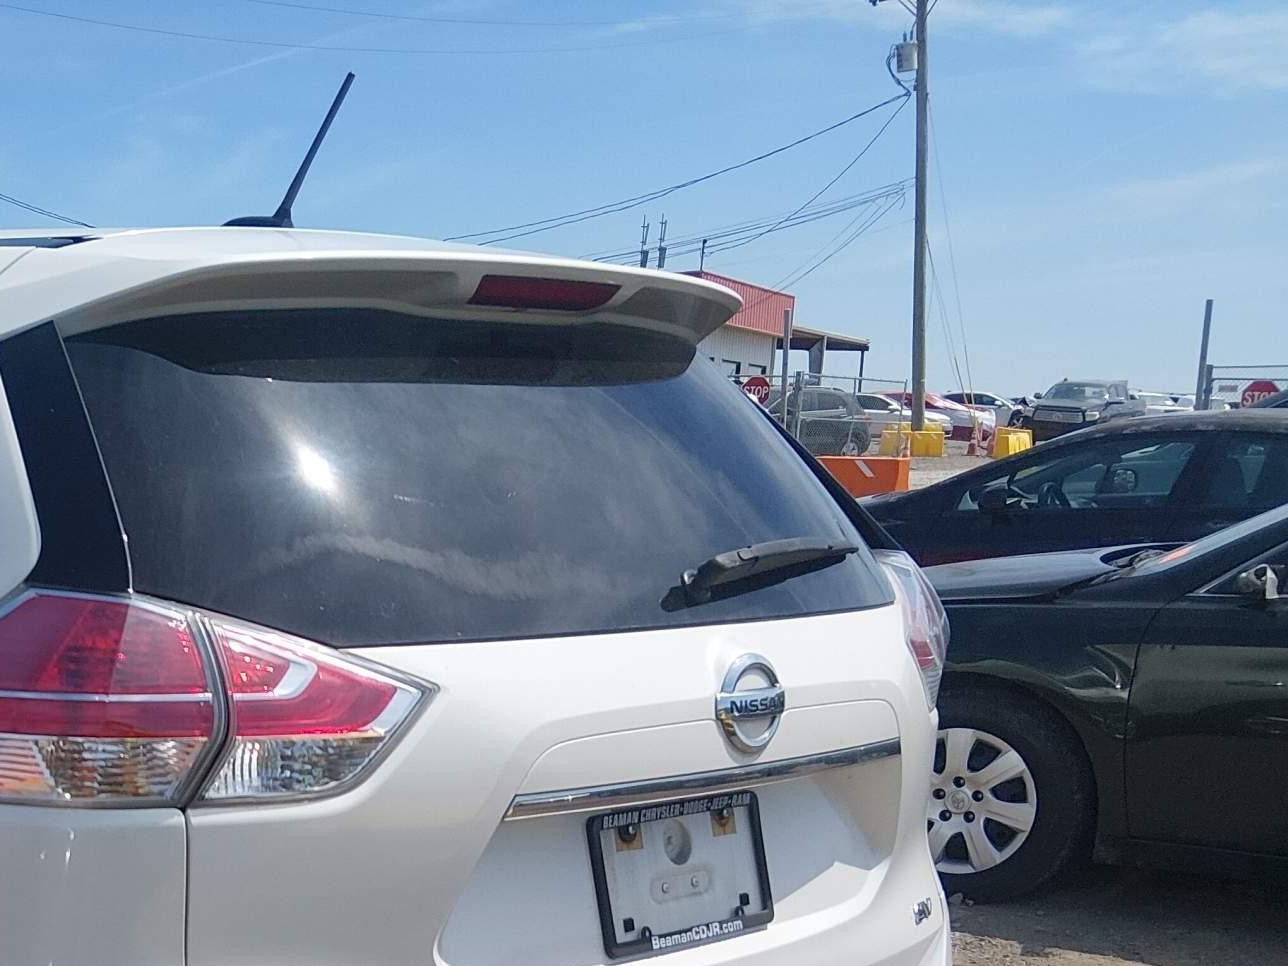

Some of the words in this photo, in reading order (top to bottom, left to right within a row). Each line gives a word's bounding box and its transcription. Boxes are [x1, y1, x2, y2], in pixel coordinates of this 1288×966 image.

[743, 385, 769, 398] STOP
[602, 810, 640, 829] BEAMAN
[651, 919, 743, 950] BeamanCDJR.com
